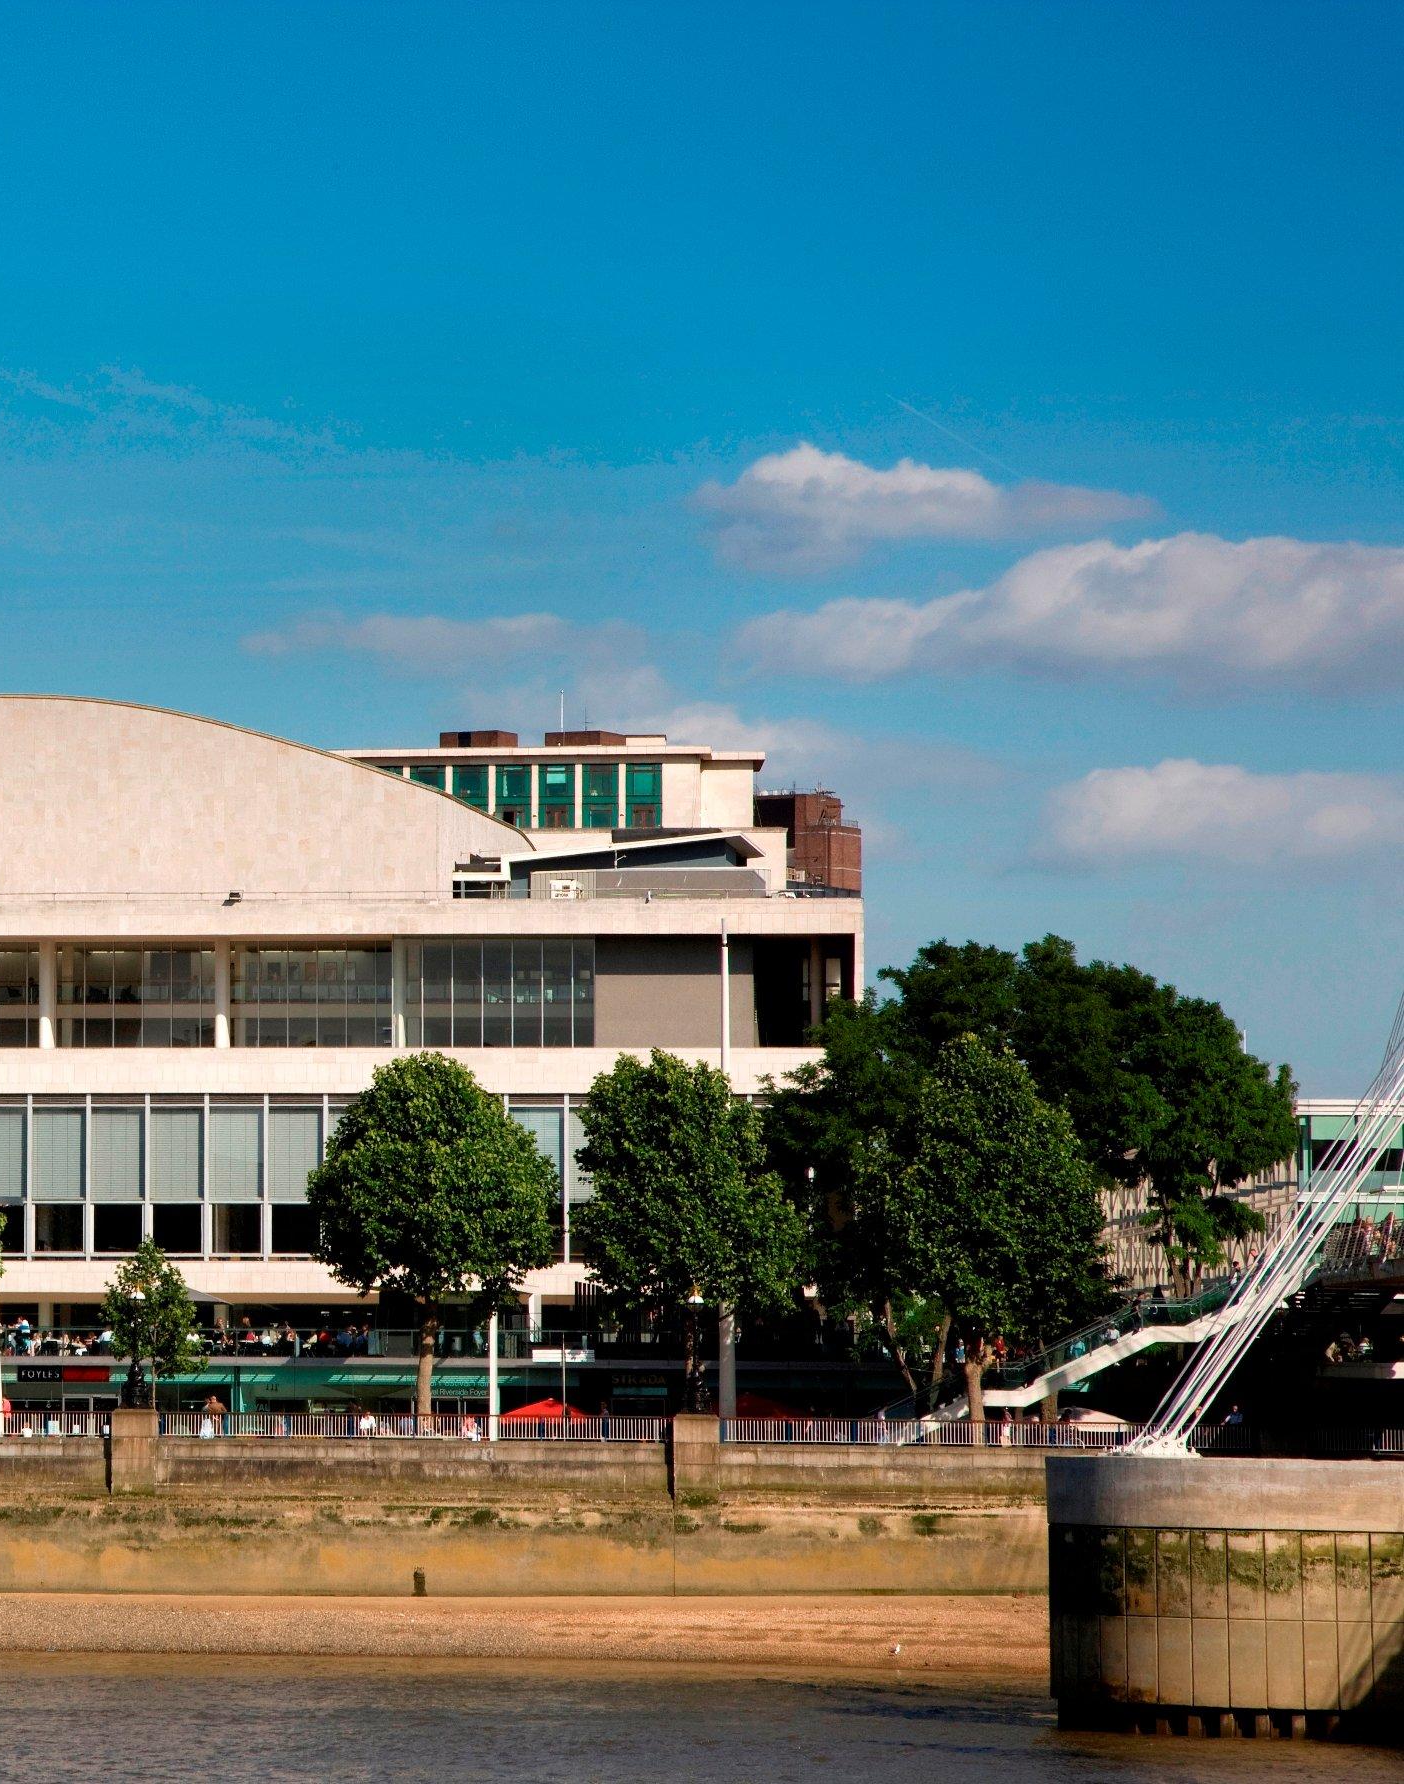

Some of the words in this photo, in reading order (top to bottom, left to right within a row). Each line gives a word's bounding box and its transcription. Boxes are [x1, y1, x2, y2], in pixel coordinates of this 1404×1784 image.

[21, 1369, 60, 1379] FOYLES
[439, 1388, 469, 1396] Riverside
[469, 1388, 488, 1397] Foyer
